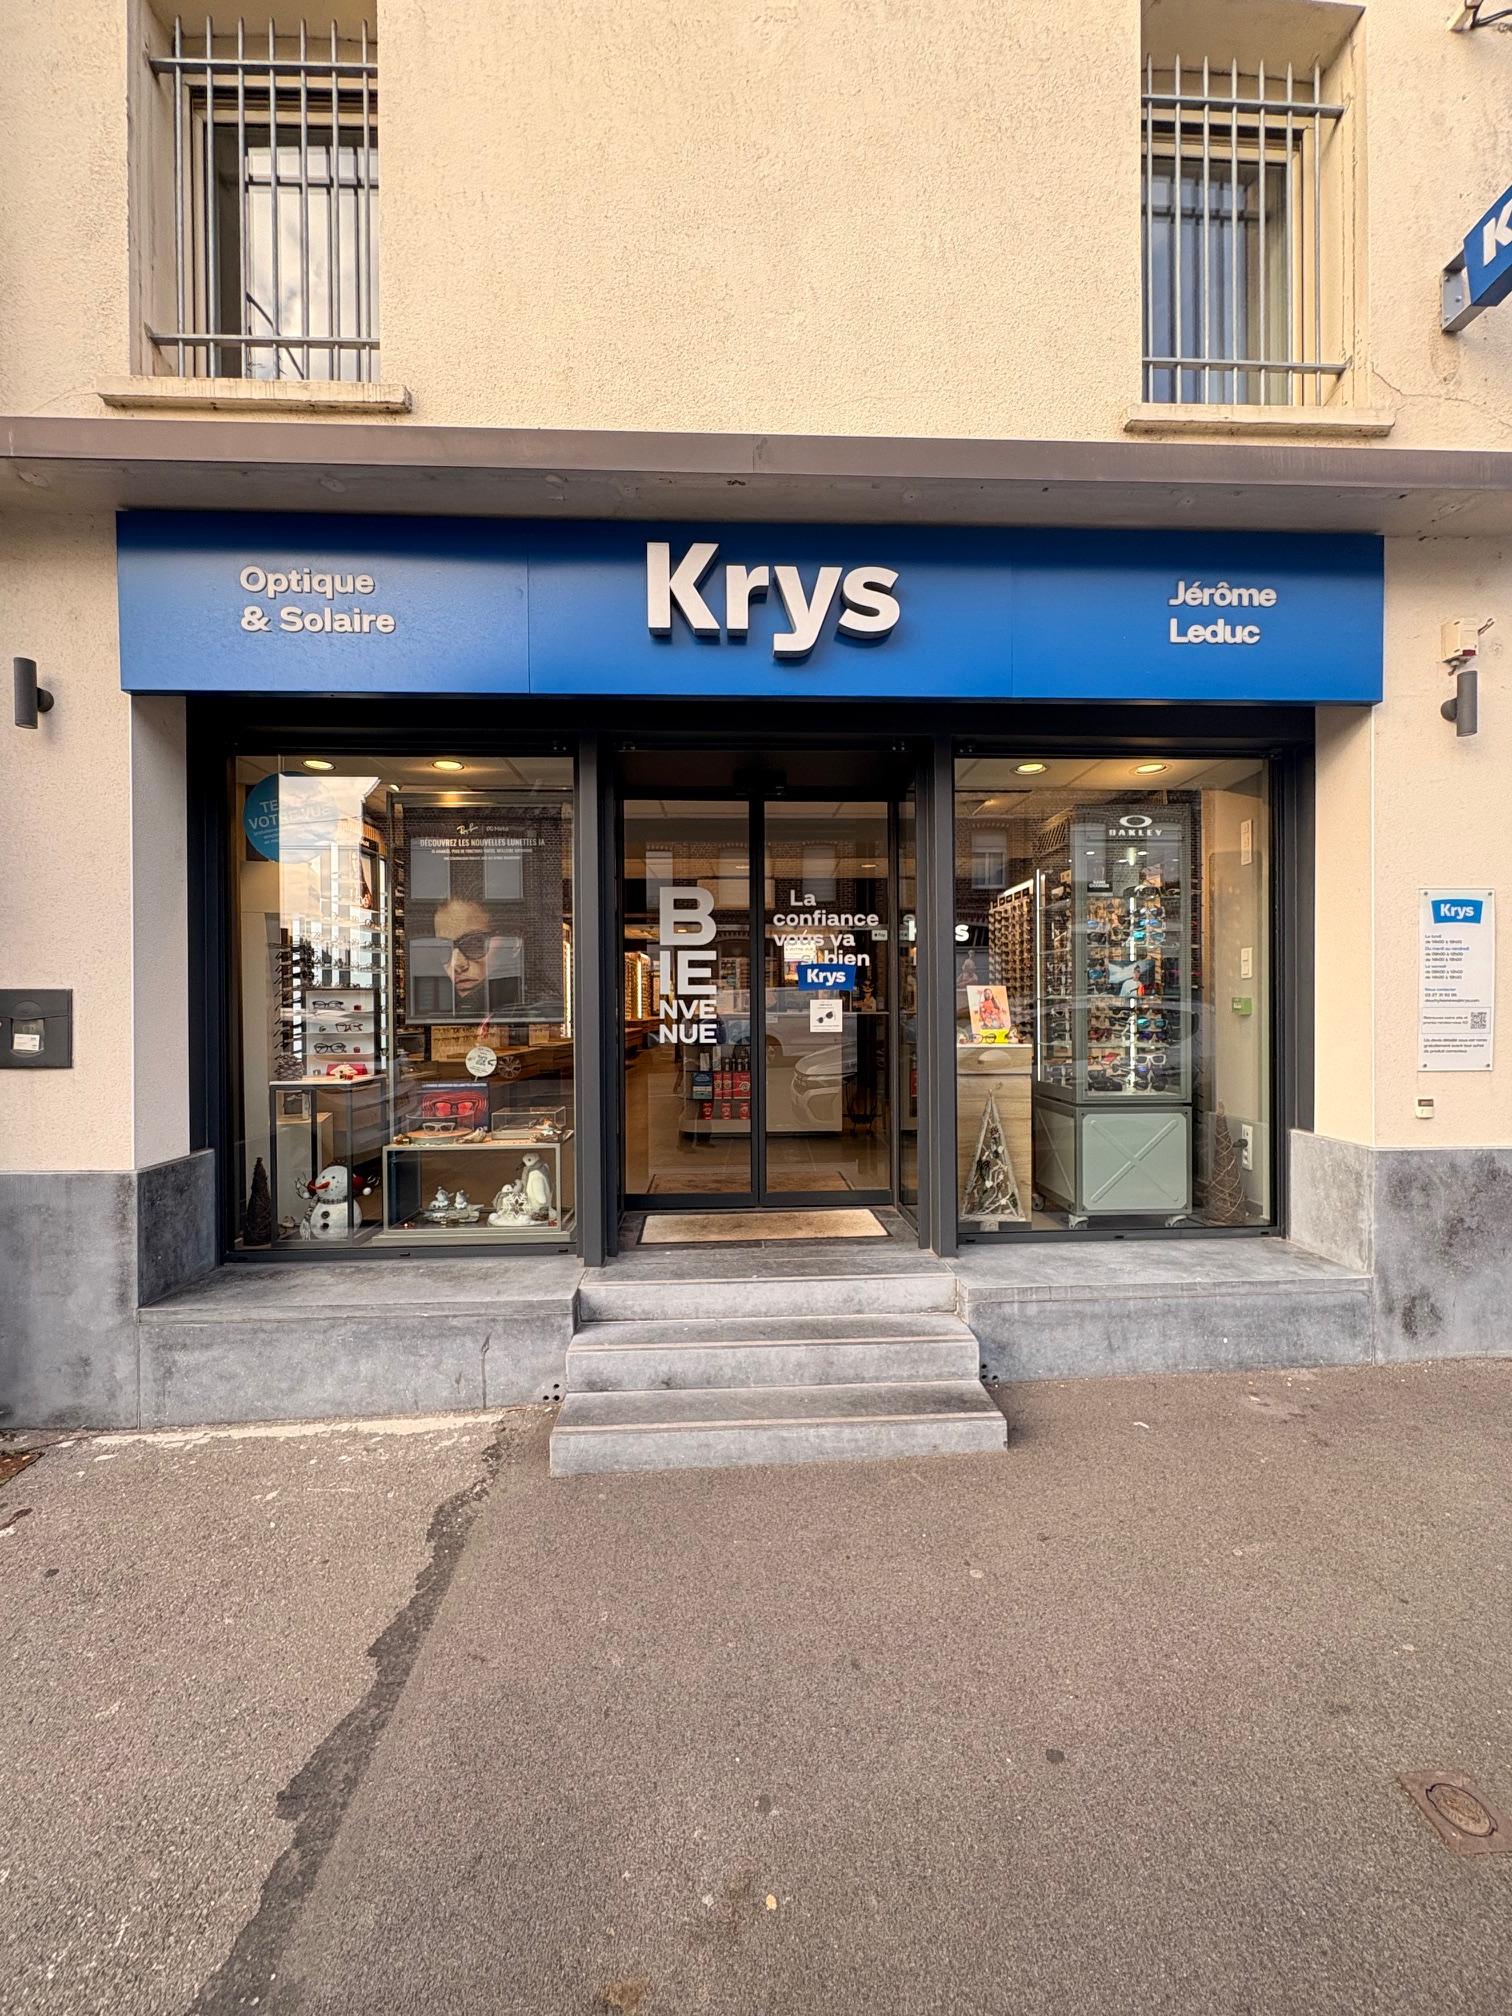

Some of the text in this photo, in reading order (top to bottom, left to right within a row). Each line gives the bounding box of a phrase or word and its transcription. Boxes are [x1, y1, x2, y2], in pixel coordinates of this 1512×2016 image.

[239, 565, 375, 599] Optique
[646, 541, 901, 655] Krys
[1168, 580, 1278, 608] Jérôme
[239, 605, 397, 635] & Solaire
[1169, 617, 1261, 645] Leduc
[419, 837, 457, 847] DÉCOUVREZ
[458, 838, 470, 847] LES
[470, 838, 505, 847] NOUVELLES
[506, 838, 537, 846] LUNETTES
[1108, 829, 1163, 837] OAKLEY
[790, 889, 817, 907] La
[772, 909, 880, 927] confiance
[1440, 903, 1475, 920] Krys
[773, 933, 856, 947] vous va
[823, 949, 870, 967] bien
[806, 968, 847, 987] Krys
